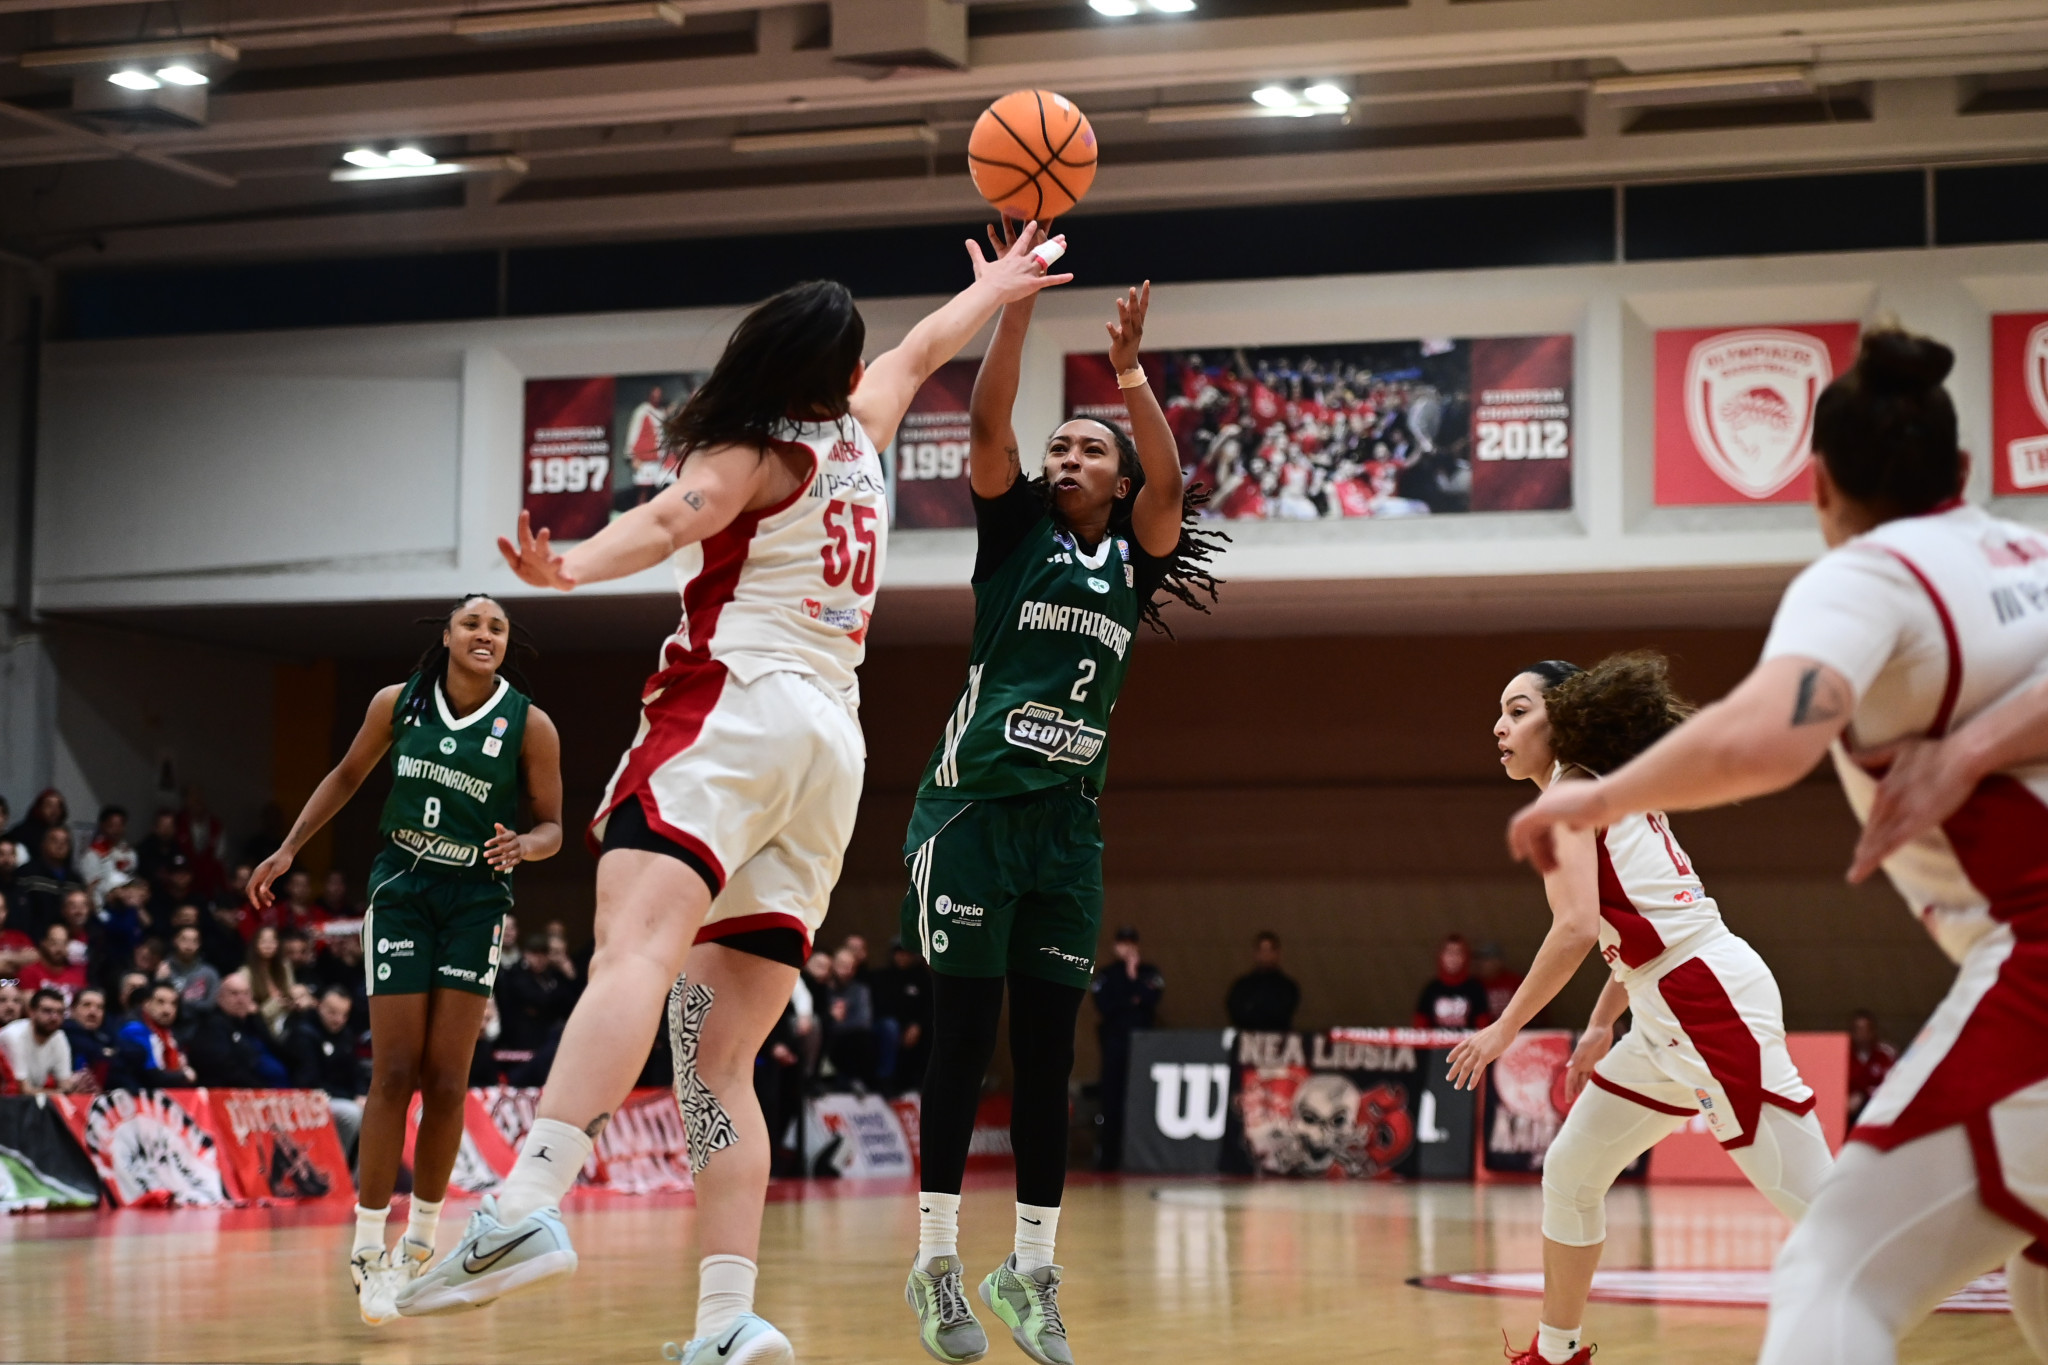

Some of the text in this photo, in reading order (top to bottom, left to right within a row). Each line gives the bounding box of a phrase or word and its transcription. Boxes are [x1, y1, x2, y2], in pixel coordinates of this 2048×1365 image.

[1477, 420, 1569, 461] 2012
[528, 455, 609, 494] 1997
[821, 498, 878, 597] 55
[1070, 659, 1097, 703] 2
[1026, 707, 1056, 722] pame
[397, 755, 493, 804] ANATHINAIKOS
[422, 796, 442, 829] 8
